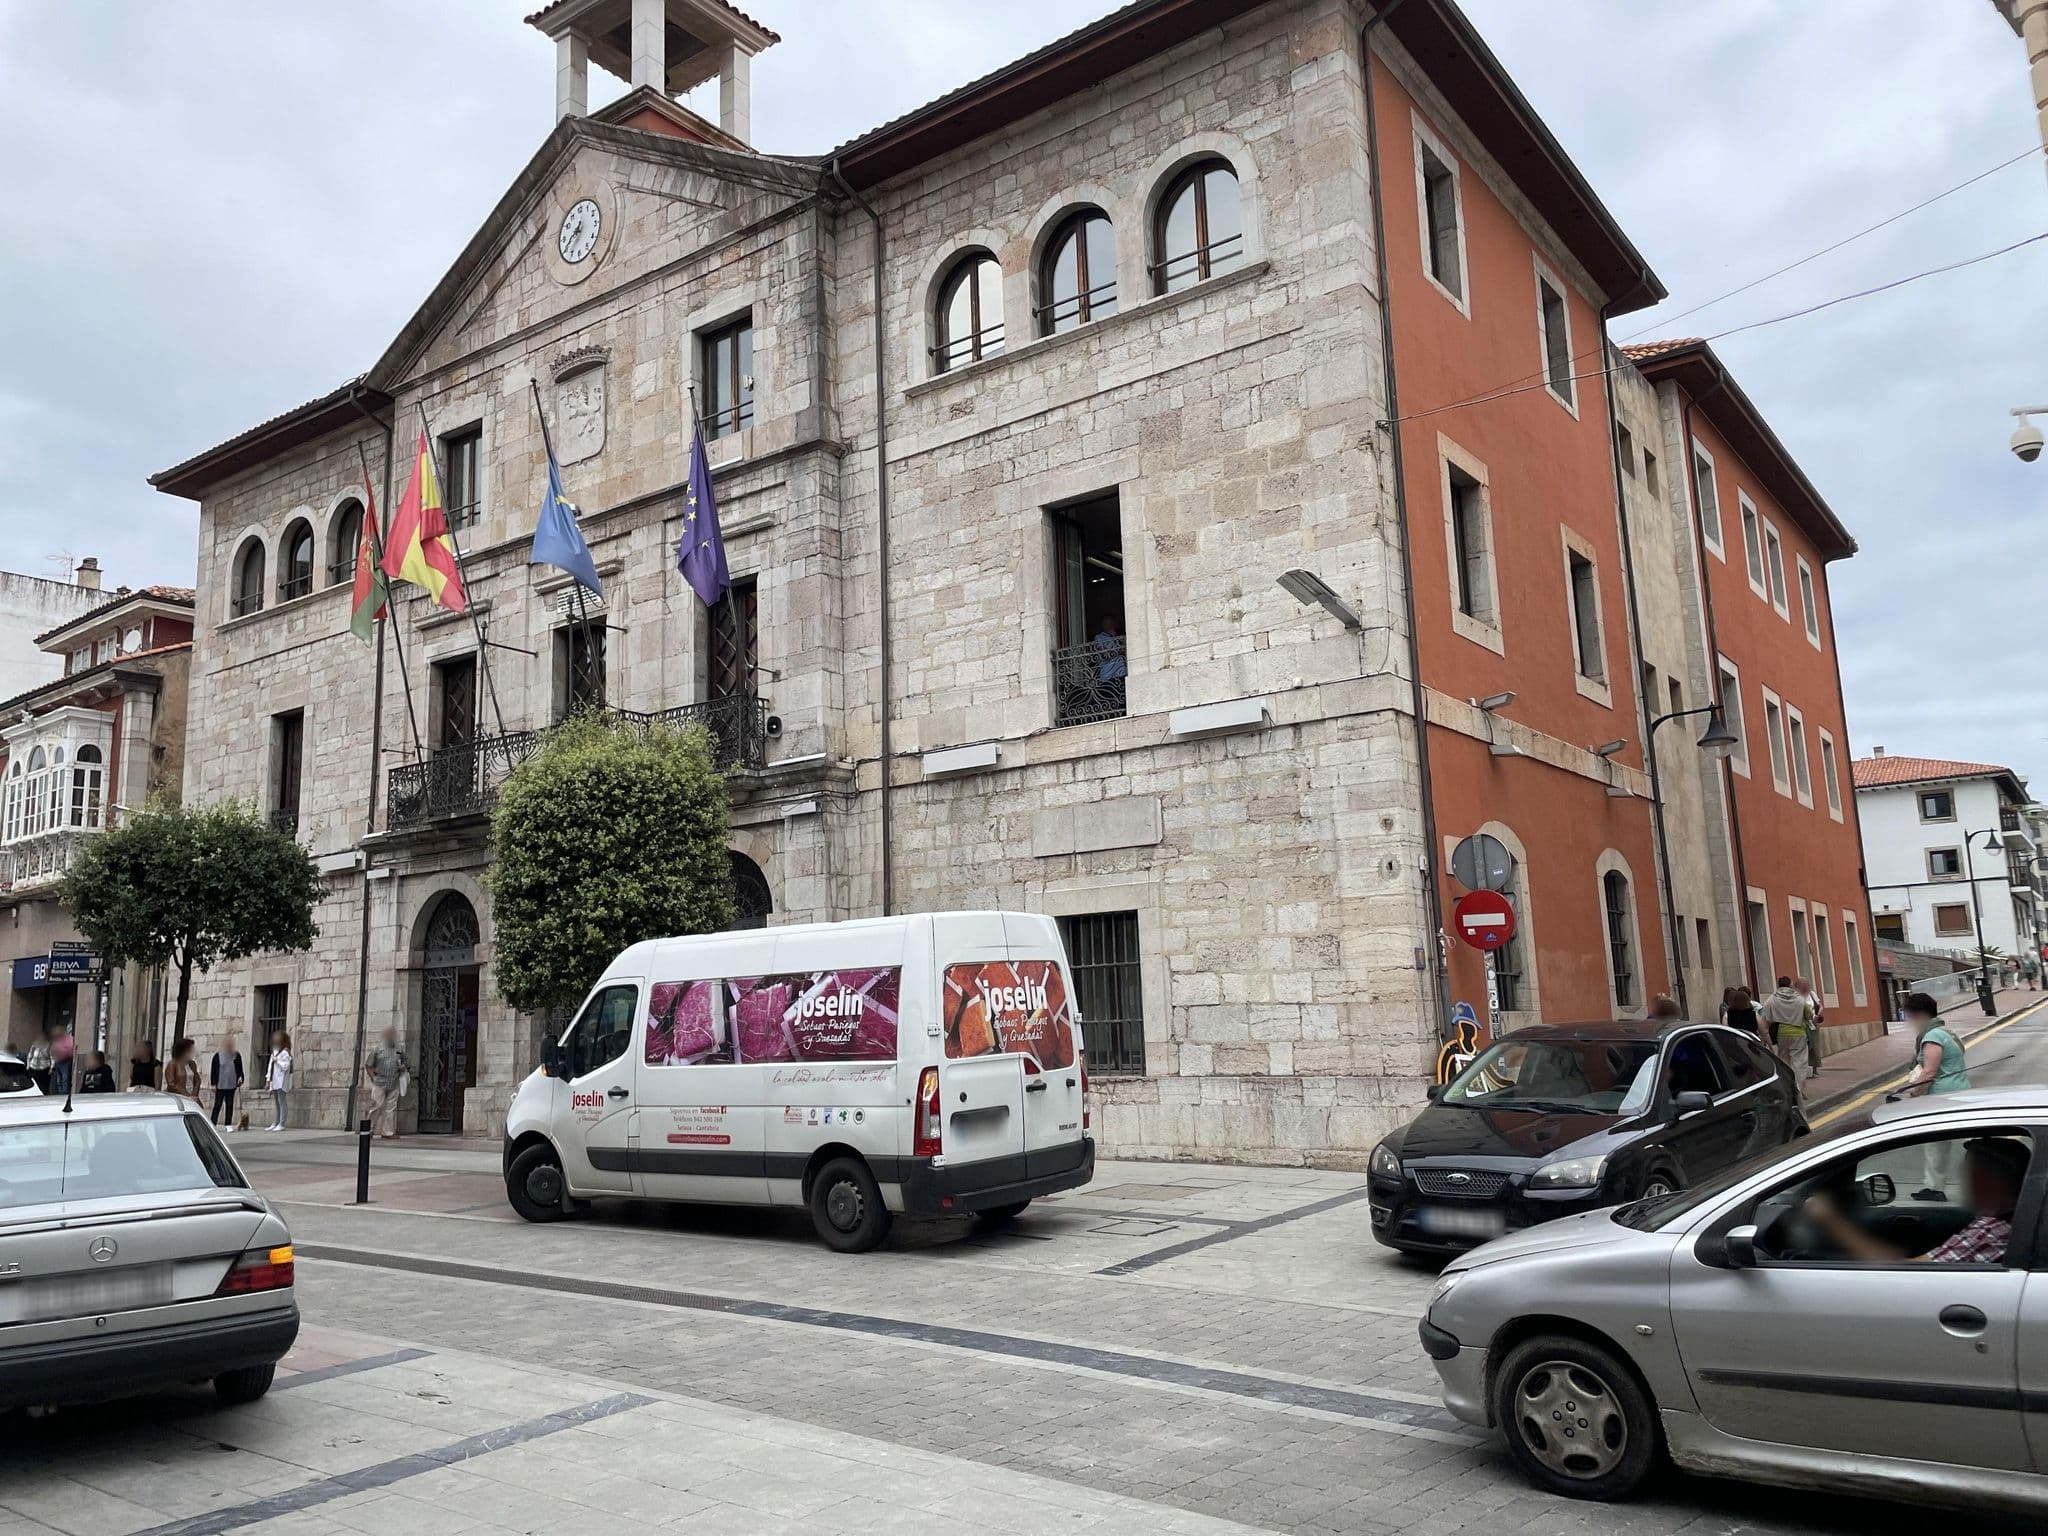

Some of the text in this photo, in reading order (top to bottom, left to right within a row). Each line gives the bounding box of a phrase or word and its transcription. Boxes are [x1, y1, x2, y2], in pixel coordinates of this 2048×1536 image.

[52, 961, 80, 969] BBVA
[794, 986, 864, 1026] joselin
[982, 976, 1049, 1022] joselin
[571, 1090, 604, 1110] joselin
